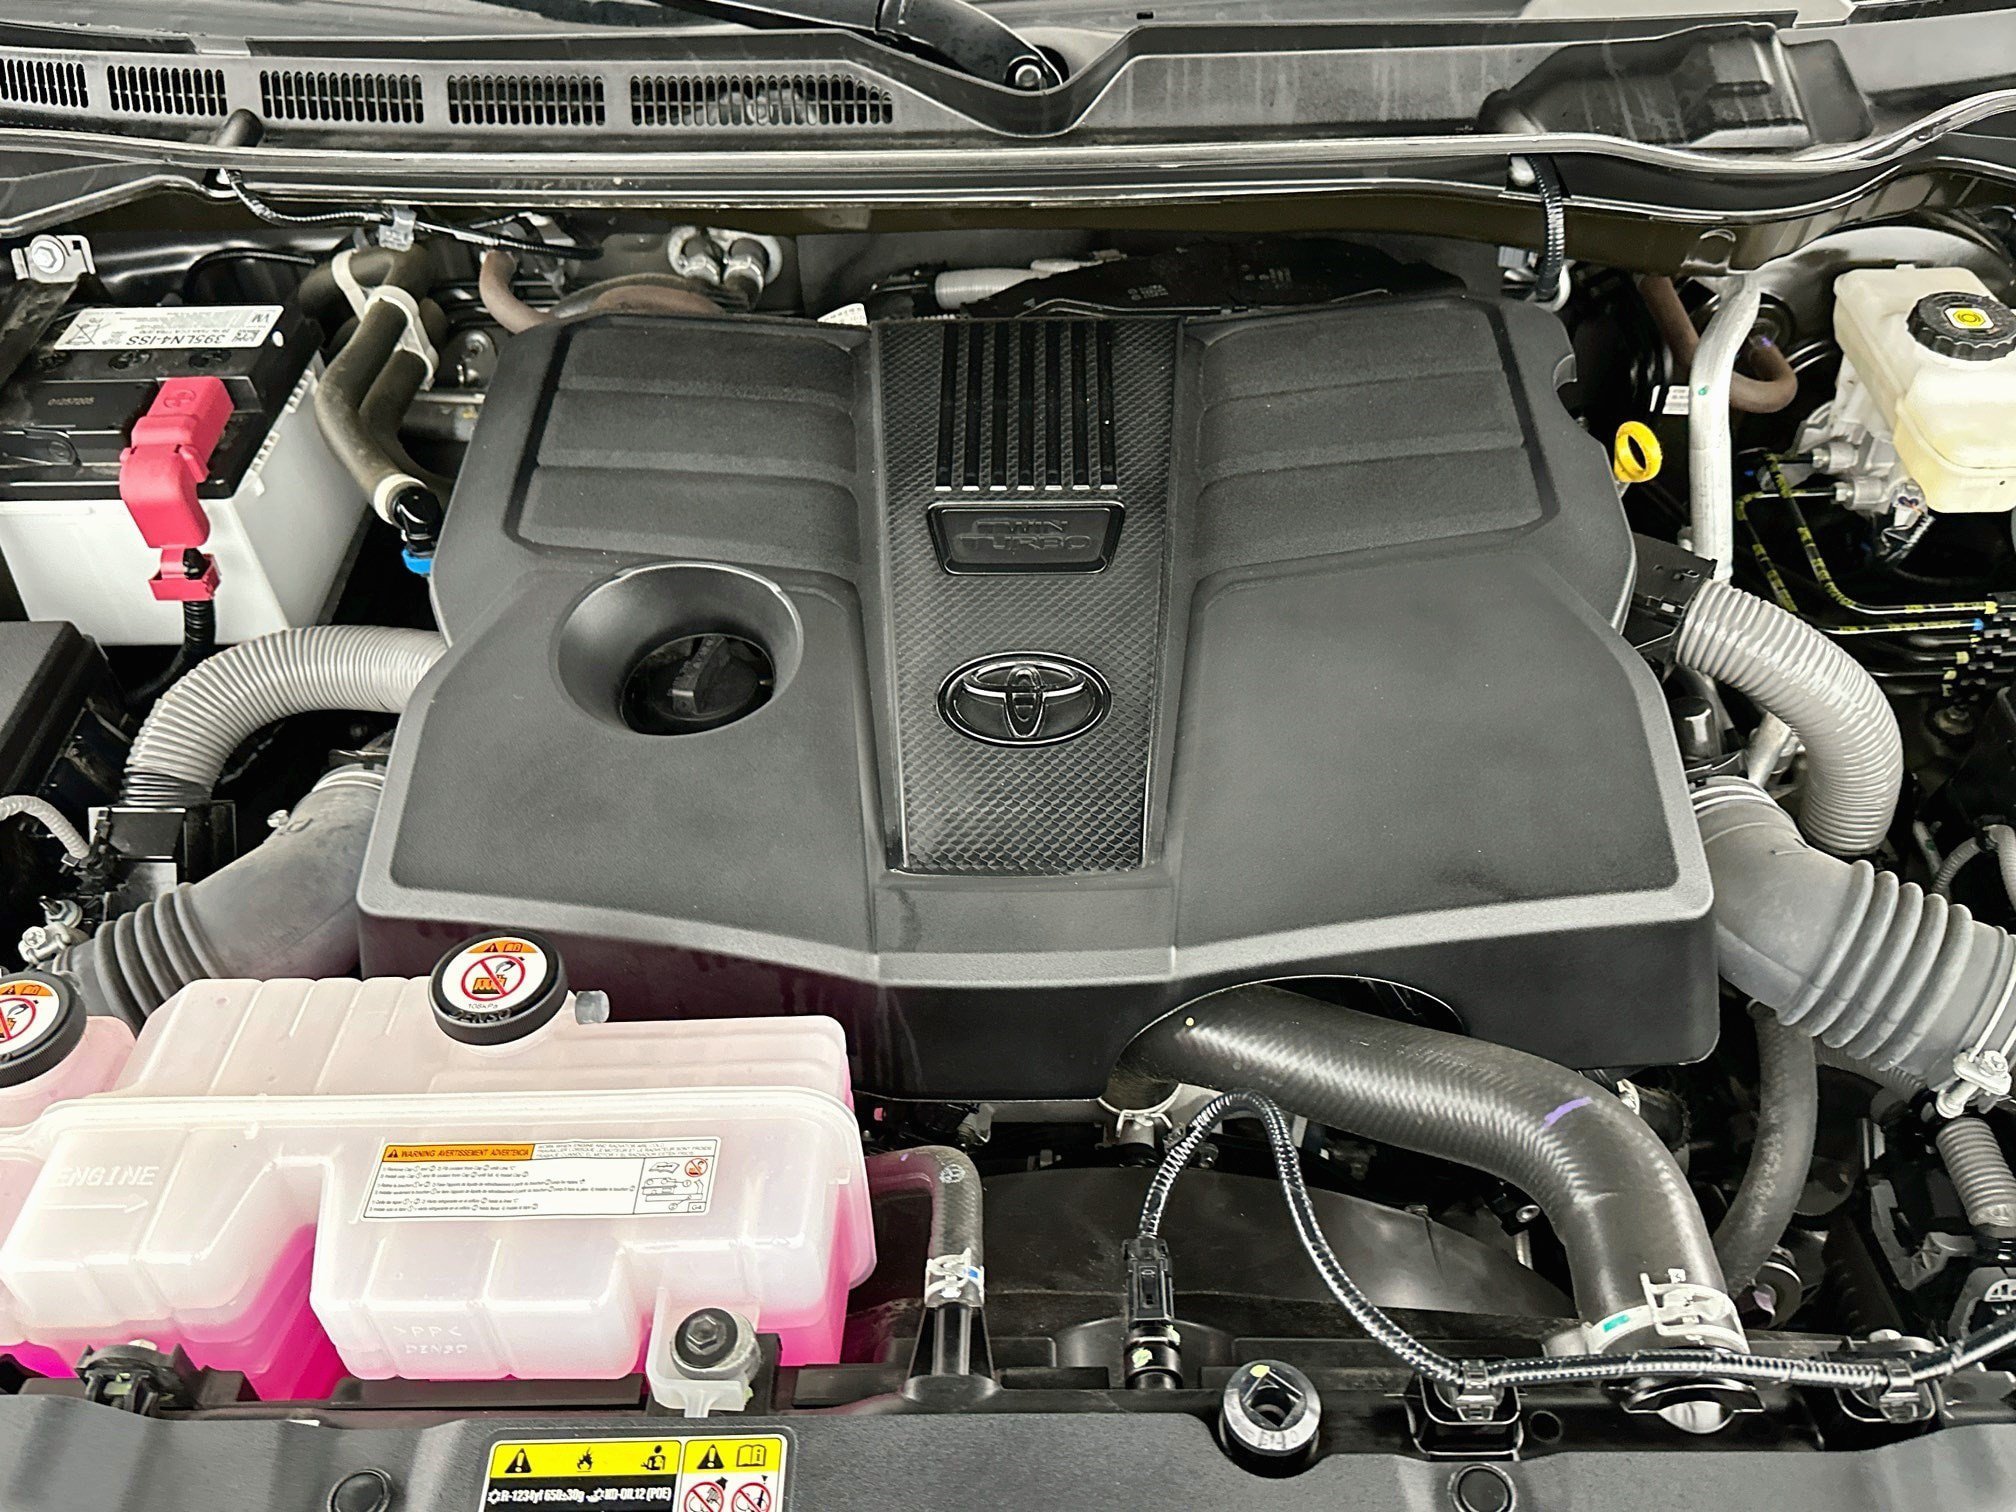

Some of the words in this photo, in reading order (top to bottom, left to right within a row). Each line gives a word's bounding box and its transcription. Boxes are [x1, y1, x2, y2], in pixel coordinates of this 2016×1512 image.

[126, 334, 226, 346] 395LN4-ISS
[974, 518, 1069, 534] TWIN
[960, 534, 1092, 551] TURBO
[401, 1149, 436, 1158] WARNING
[438, 1148, 489, 1158] AVERTISSEMENT
[490, 1147, 530, 1156] ADVERTENCIA
[56, 1166, 160, 1187] ENGINE
